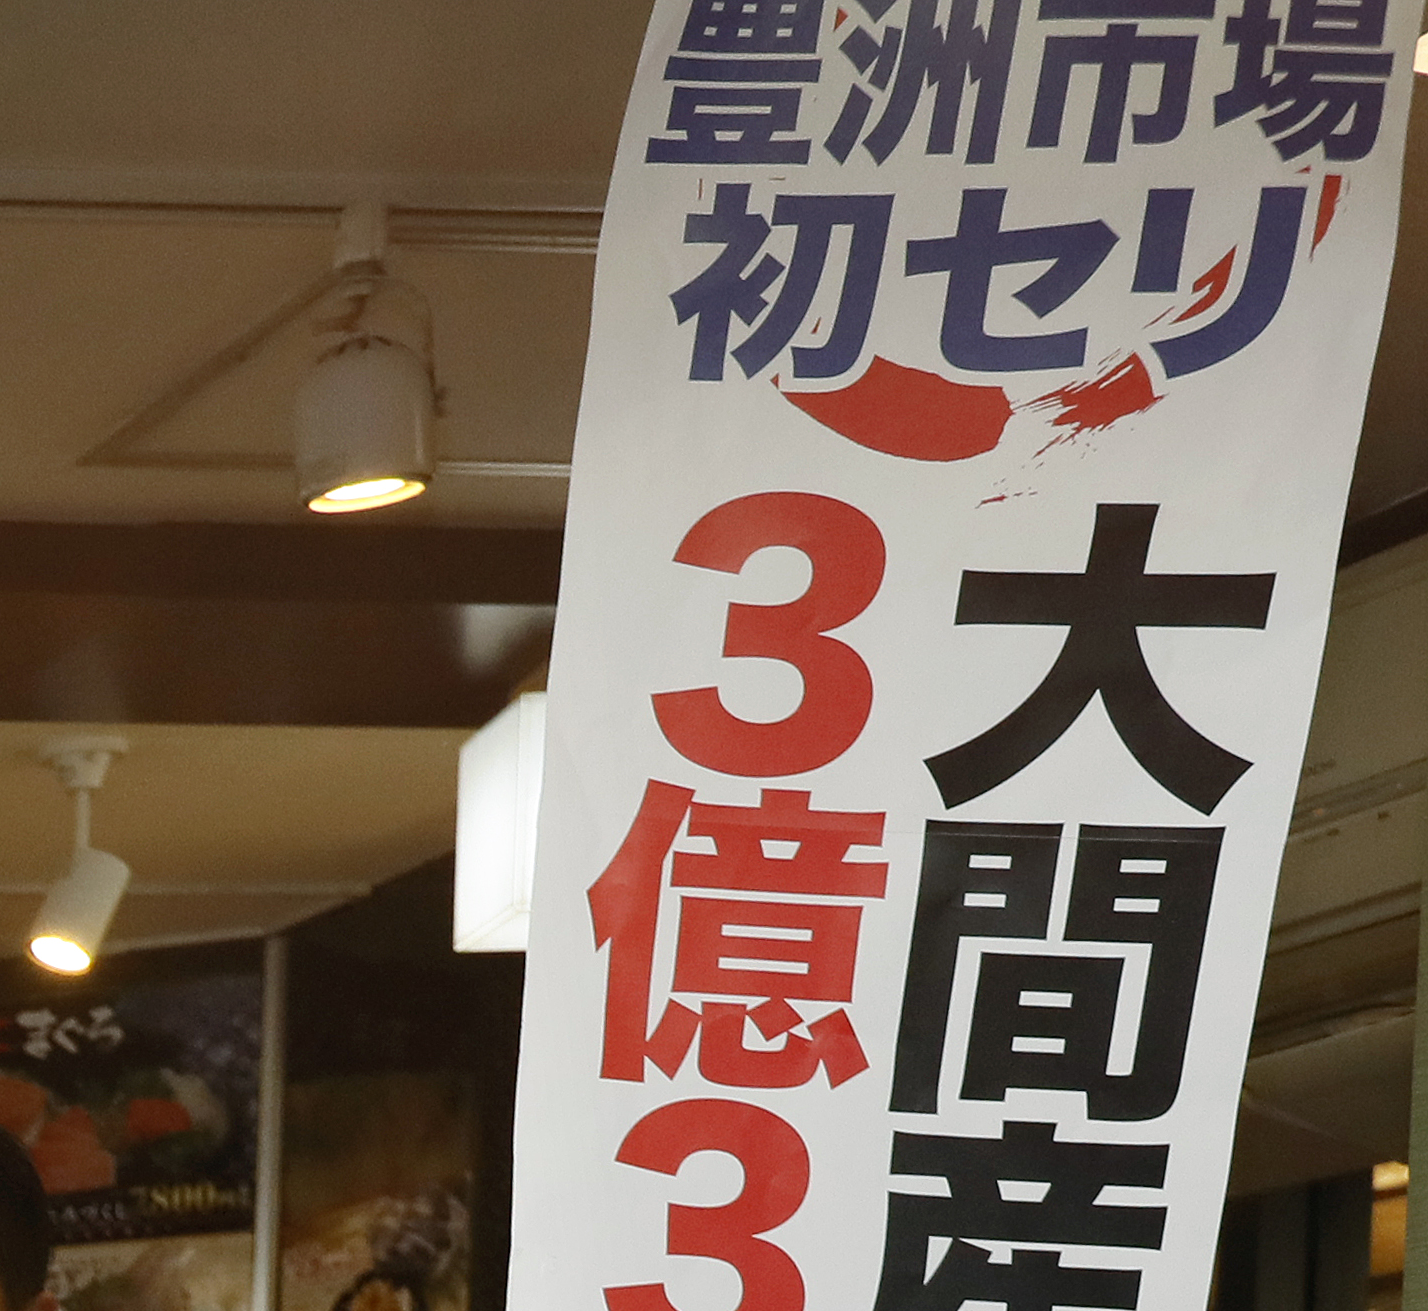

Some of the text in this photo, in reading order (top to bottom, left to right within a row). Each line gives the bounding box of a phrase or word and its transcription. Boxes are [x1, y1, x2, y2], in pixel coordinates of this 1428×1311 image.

[644, 0, 1394, 167] 豊洲市場
[669, 184, 1310, 381] 初セリ
